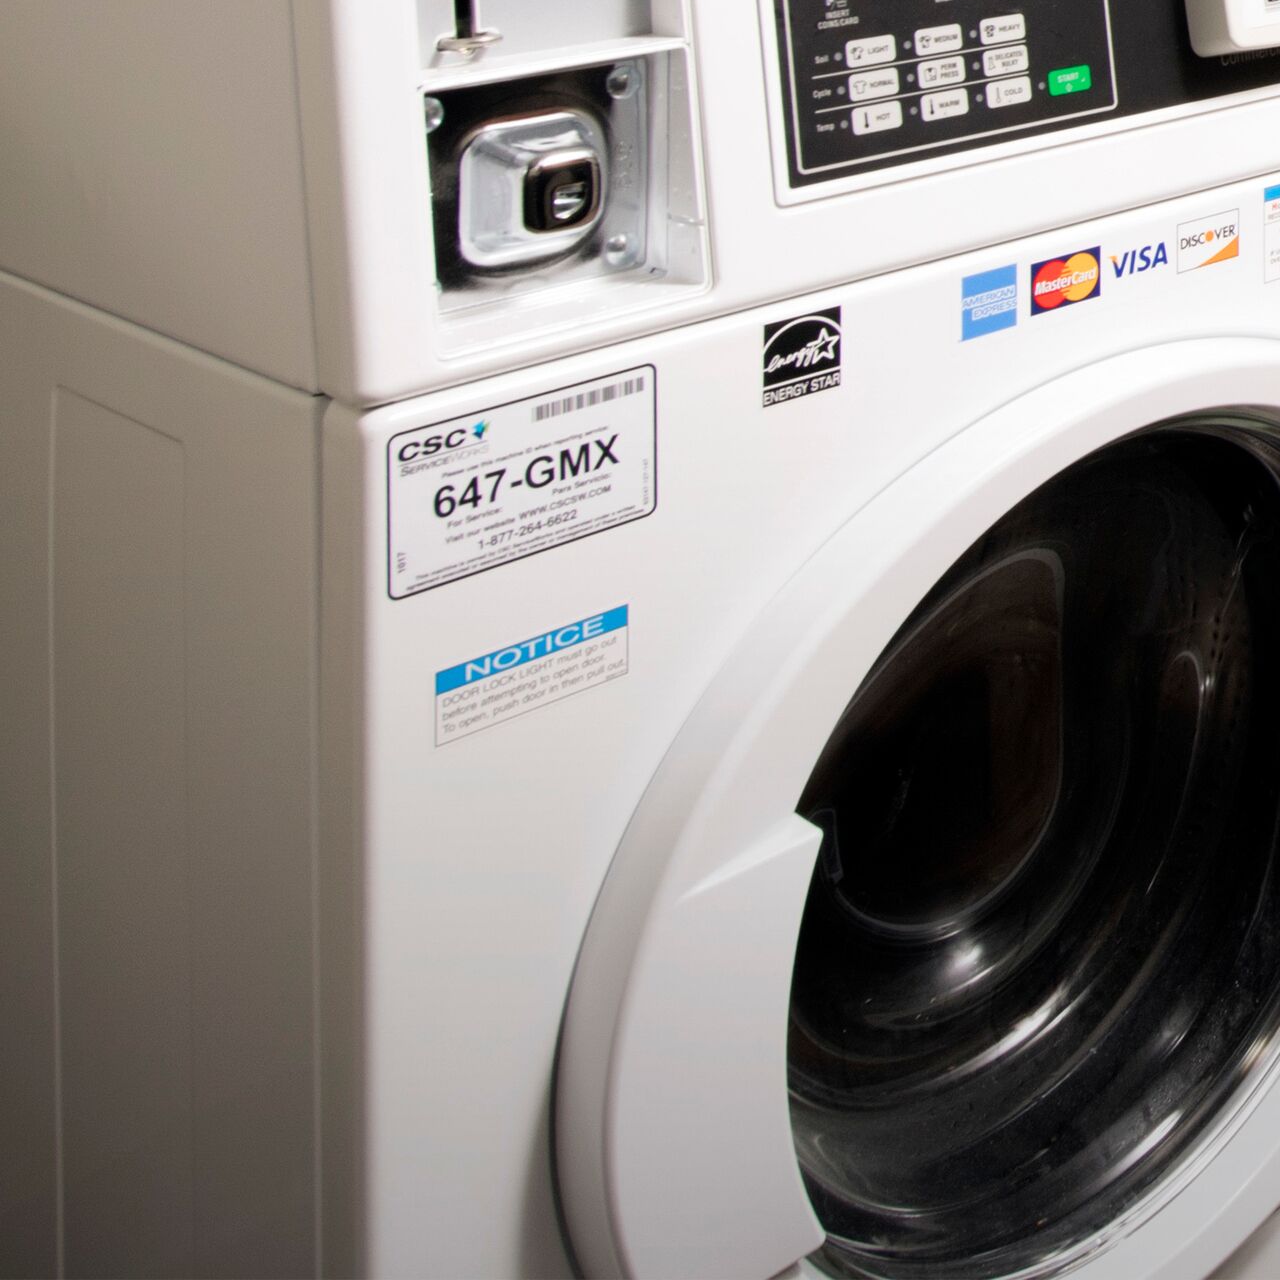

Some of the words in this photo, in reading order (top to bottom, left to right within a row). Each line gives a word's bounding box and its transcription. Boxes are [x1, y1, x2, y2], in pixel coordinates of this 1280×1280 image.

[825, 8, 850, 19] INSERT
[998, 24, 1020, 33] HEAVY
[934, 34, 958, 44] MEDIUM
[867, 45, 889, 55] LIGHT
[814, 55, 829, 64] Soil
[940, 62, 957, 70] PERM
[940, 70, 959, 79] PRESS
[1057, 72, 1079, 83] START
[869, 79, 895, 88] NORMAL
[812, 88, 832, 99] Cycle
[1004, 87, 1023, 96] COLD
[939, 100, 960, 108] WARM
[876, 113, 891, 121] HOT
[816, 123, 835, 133] Temp
[1180, 224, 1236, 250] DISCOVER
[1110, 242, 1168, 278] VISA
[1034, 267, 1098, 296] MasterCard
[962, 286, 1016, 308] AMERICAN
[973, 299, 1017, 319] EXPRESS
[764, 382, 809, 406] ENERGY
[811, 372, 840, 392] STAR
[398, 429, 466, 462] CSC
[434, 433, 620, 518] 647-GMX
[552, 485, 571, 496] Para
[445, 533, 464, 544] Visit
[467, 528, 481, 538] our
[484, 517, 515, 531] website
[519, 484, 611, 520] WWW.CSCSW.COM
[447, 519, 463, 528] For
[478, 509, 577, 549] 1-877-264-6622
[465, 615, 604, 682] NOTICE
[442, 686, 480, 708] DOOR
[483, 674, 517, 693] LOCK
[519, 660, 554, 680] LIGHT
[557, 649, 583, 665] must
[585, 645, 598, 657] go
[600, 635, 617, 649] out
[442, 701, 477, 722] before
[480, 679, 537, 707] attempting
[539, 673, 550, 684] to
[553, 663, 579, 680] open
[442, 722, 456, 734] To
[458, 711, 489, 729] open,
[493, 697, 520, 718] push
[522, 689, 547, 705] door
[550, 684, 559, 693] in
[561, 674, 584, 690] then
[586, 667, 605, 683] pull
